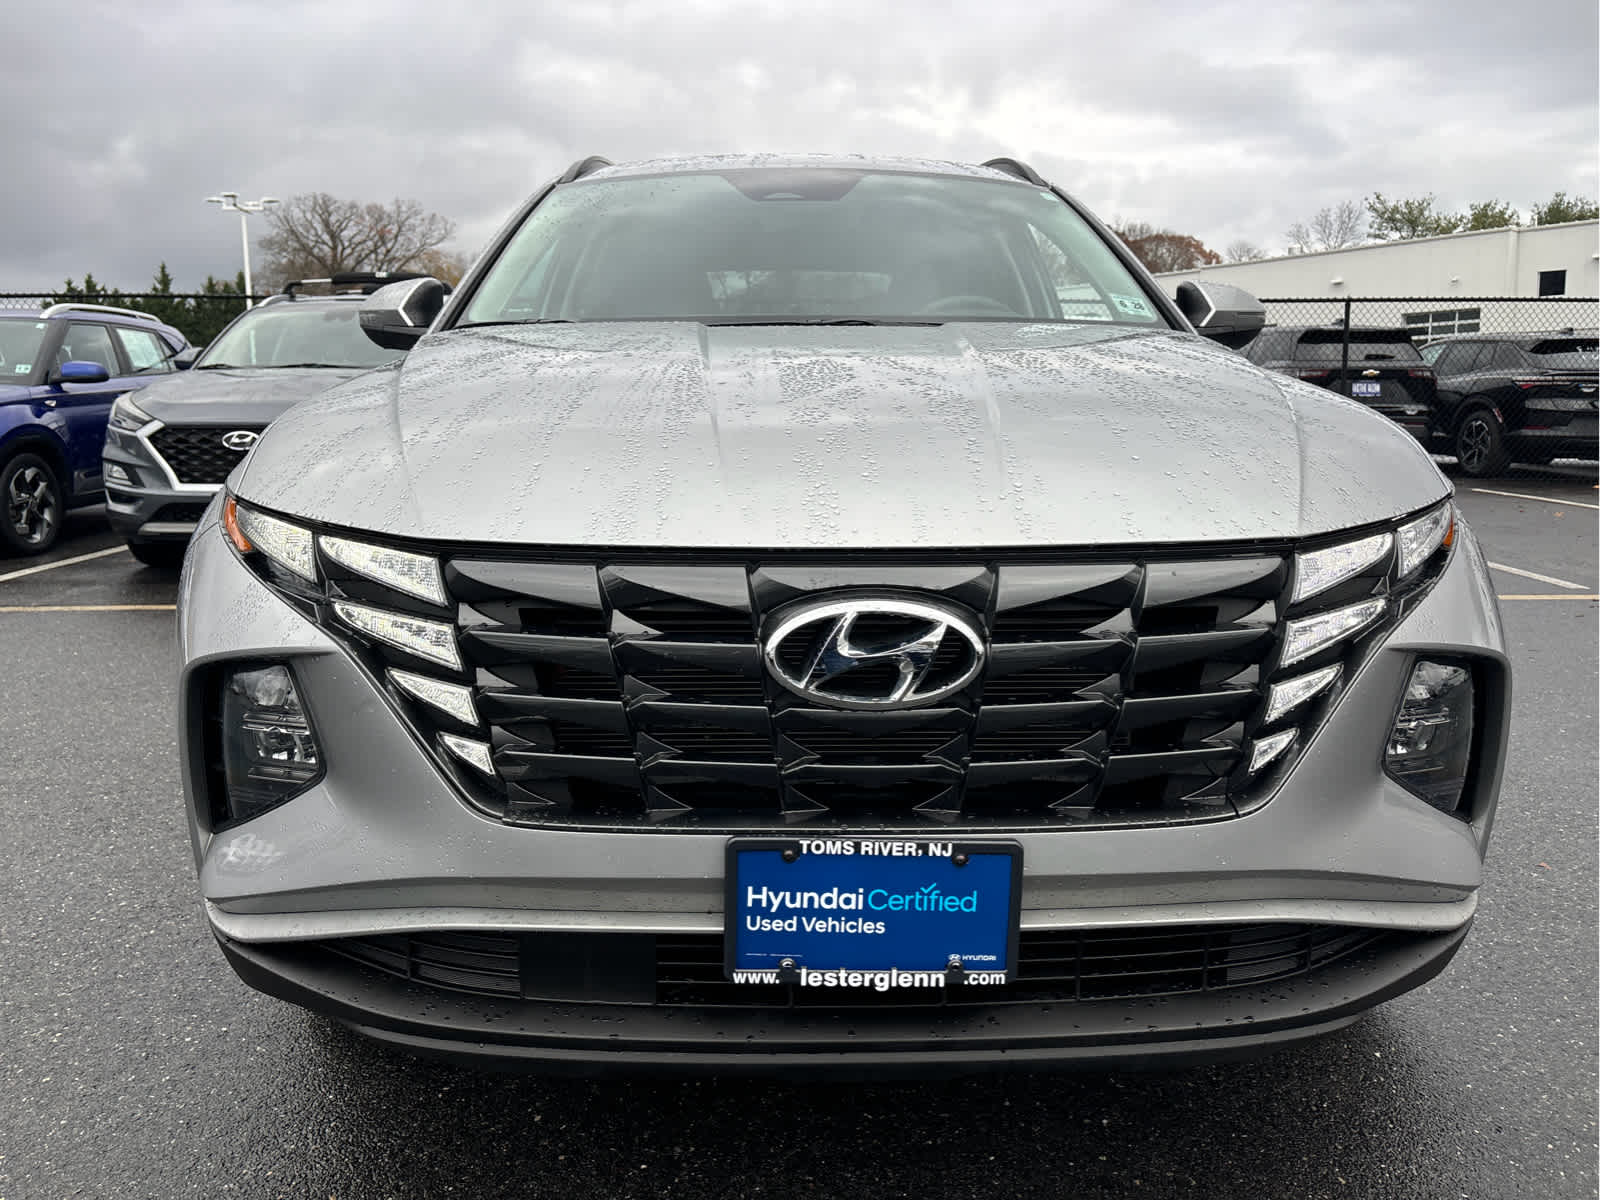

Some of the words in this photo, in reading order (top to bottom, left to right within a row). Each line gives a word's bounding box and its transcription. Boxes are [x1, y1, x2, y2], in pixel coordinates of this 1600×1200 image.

[800, 840, 855, 856] TOMS
[861, 841, 923, 857] RIVER,
[928, 843, 952, 857] NJ
[747, 886, 864, 912] Hyundai
[868, 883, 977, 912] Certified
[746, 915, 797, 932] Used
[801, 917, 886, 934] Vehicles
[733, 972, 780, 985] www.
[800, 968, 945, 992] lesterglenn
[963, 972, 1006, 985] .com
